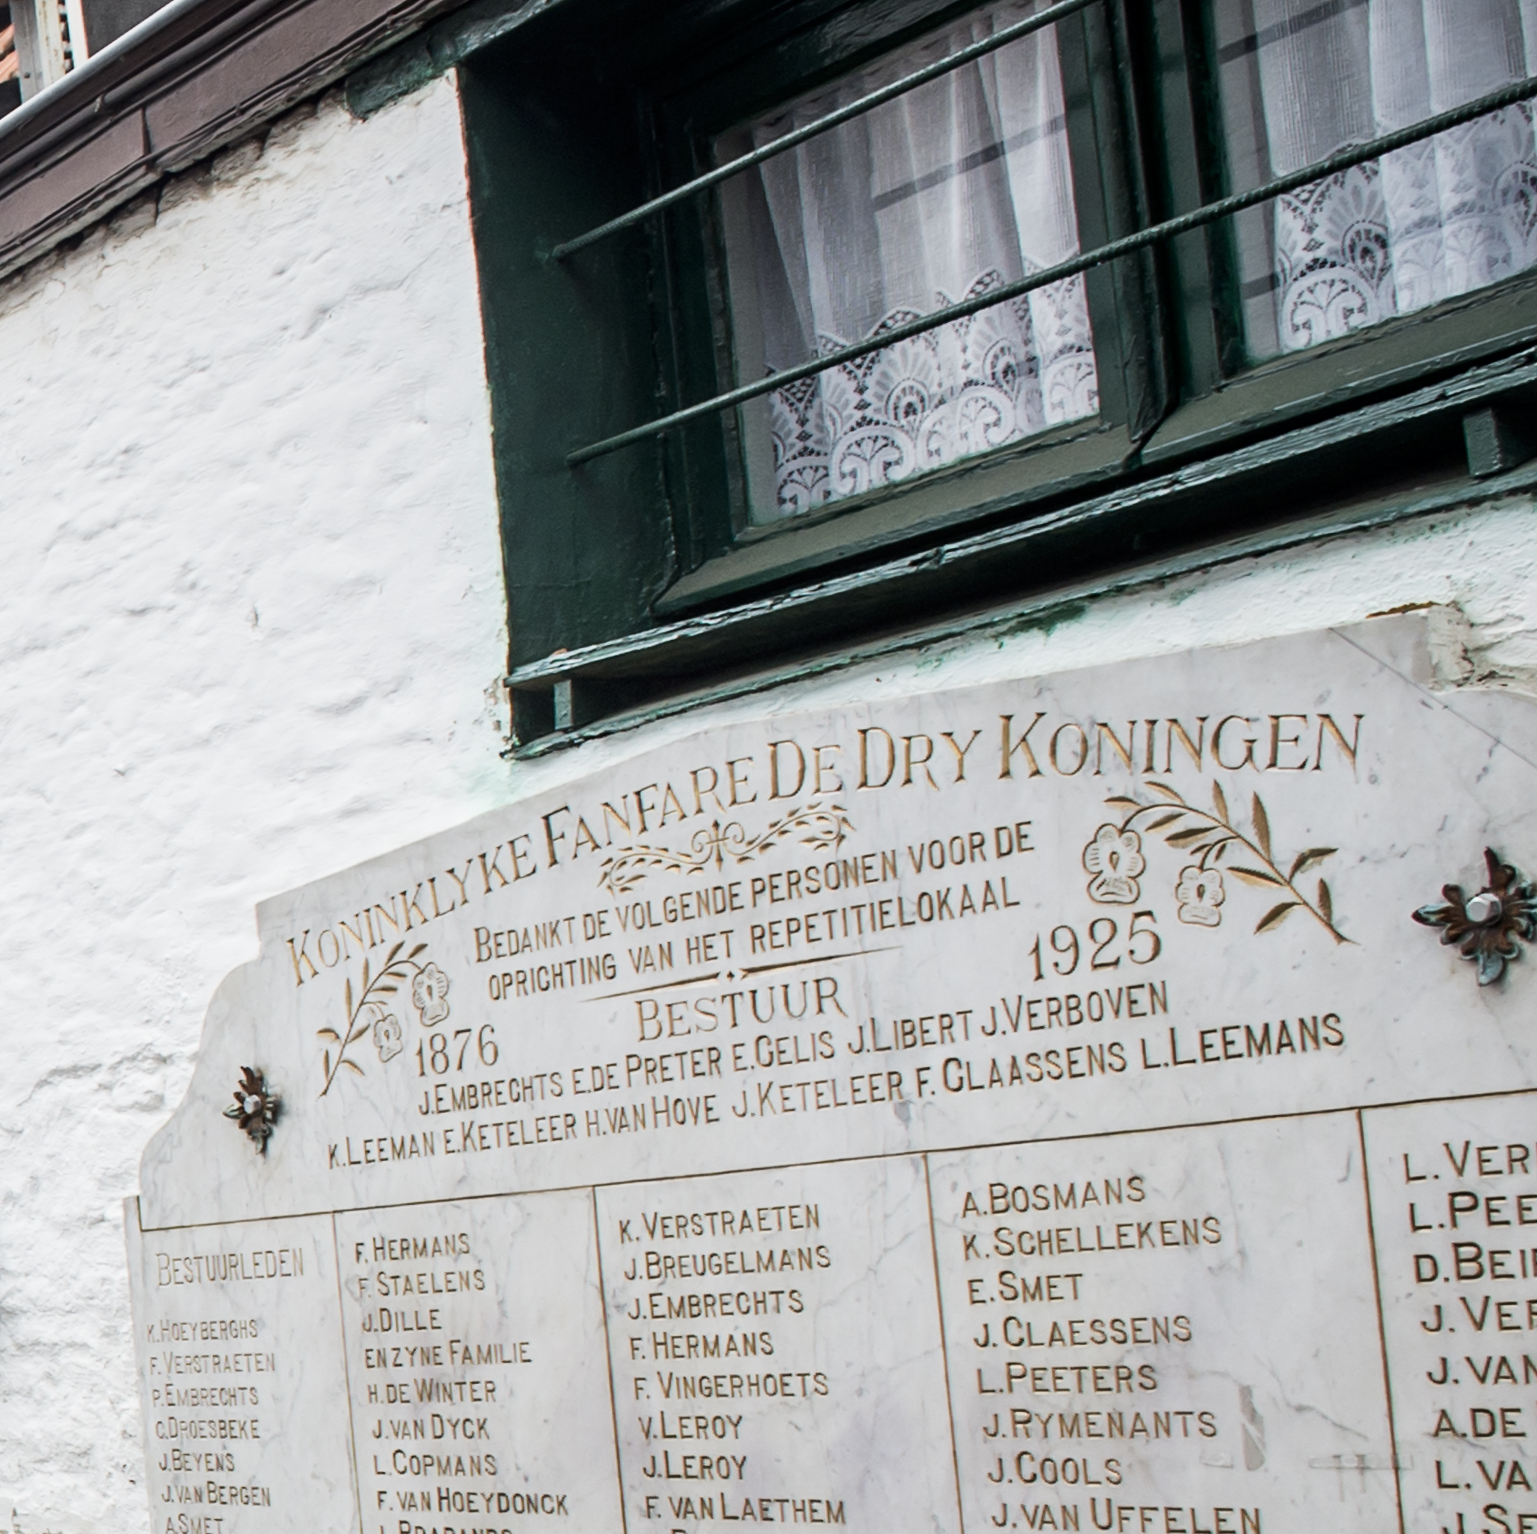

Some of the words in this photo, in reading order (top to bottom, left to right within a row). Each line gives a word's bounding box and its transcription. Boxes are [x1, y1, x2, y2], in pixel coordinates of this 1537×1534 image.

[286, 833, 536, 988] KONINKLYKE
[540, 756, 758, 868] FANFARE
[767, 739, 844, 801] DE
[857, 726, 983, 791] DRY
[998, 711, 1367, 782] KONINGEN
[473, 907, 576, 962] BEDANKT
[582, 908, 611, 941] DE
[615, 880, 745, 934] VOLGENDE
[750, 848, 898, 908] PERSONEN
[908, 829, 988, 876] VOOR
[997, 820, 1035, 859] DE
[488, 951, 616, 1001] OPRICHTING
[628, 940, 673, 975] VAN
[686, 929, 735, 965] HET
[750, 874, 1021, 953] REPETITIELOKAAL
[1025, 909, 1165, 984] 1925
[634, 965, 847, 1045] BESTUUR
[414, 1023, 499, 1077] 1876
[155, 1241, 304, 1286] BESTUURLEDEN
[448, 1338, 532, 1366] FAMILIE
